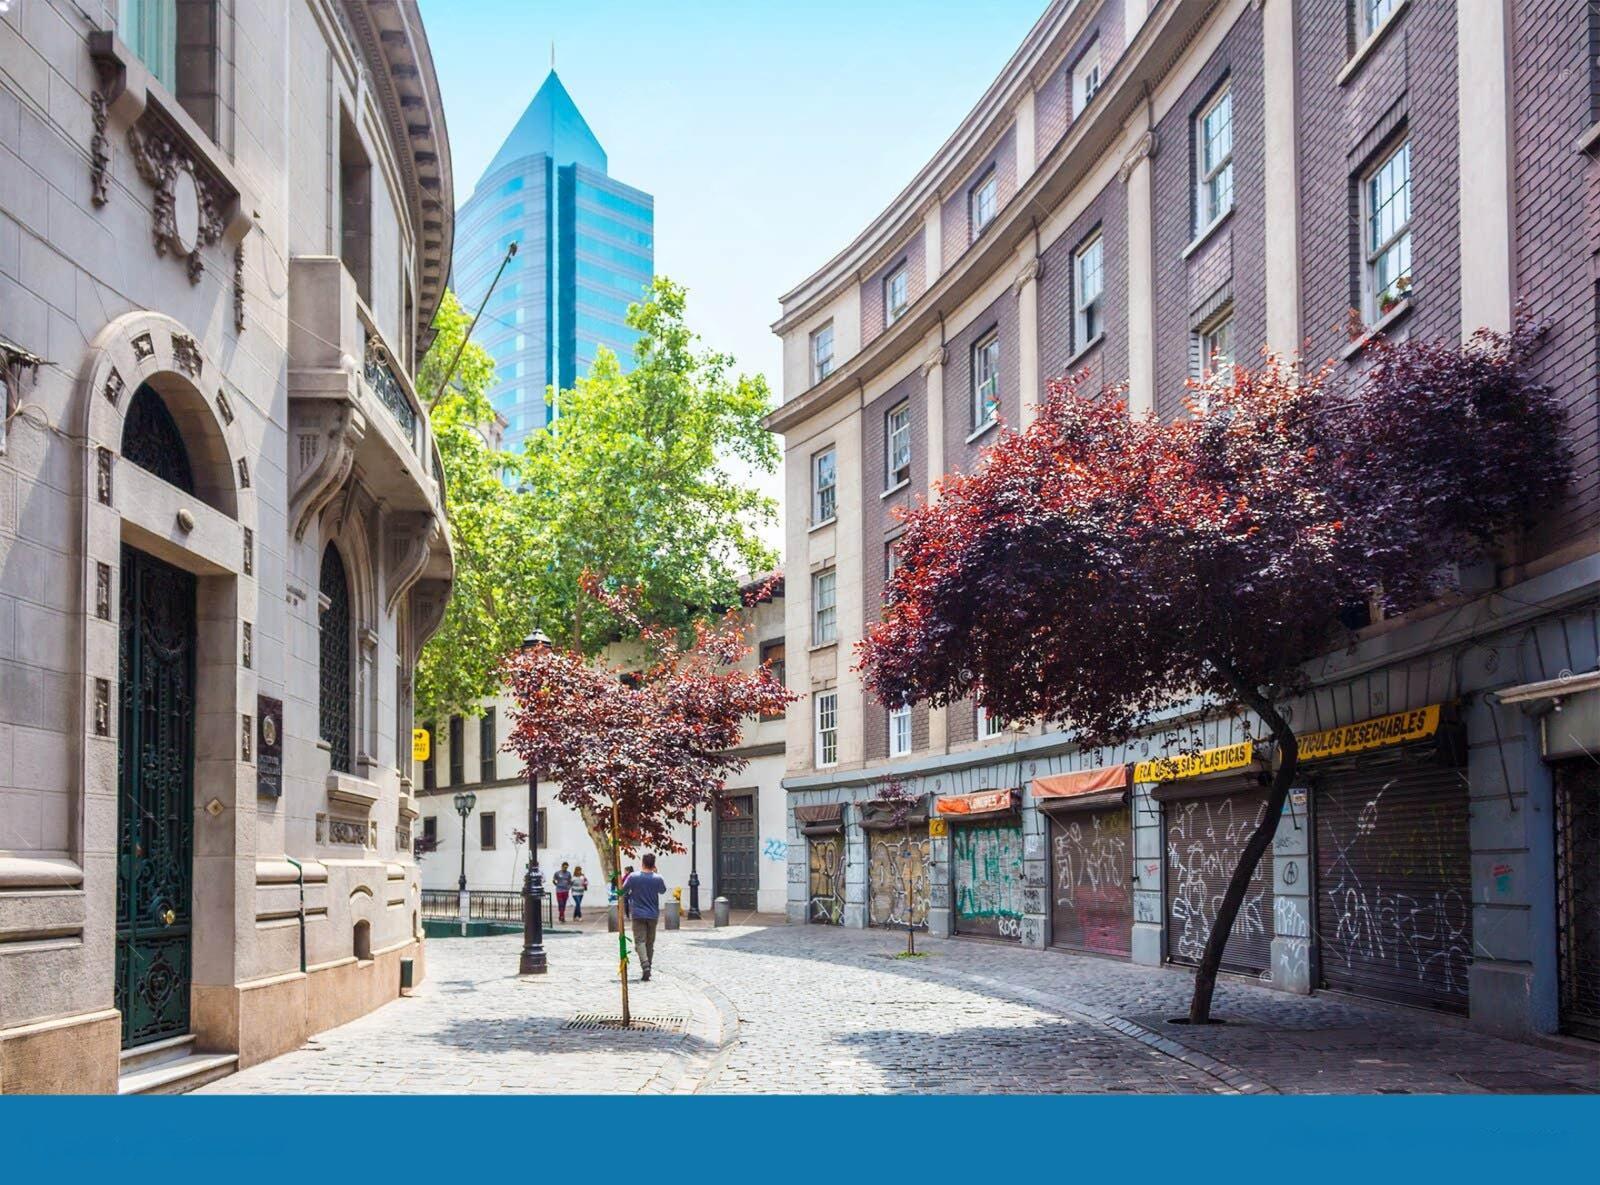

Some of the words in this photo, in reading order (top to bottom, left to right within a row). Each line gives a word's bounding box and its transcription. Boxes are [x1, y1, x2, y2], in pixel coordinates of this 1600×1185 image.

[1297, 727, 1343, 755] RTICULOS
[1344, 710, 1427, 746] DESECHABLES
[1199, 745, 1246, 770] PLASTICAS
